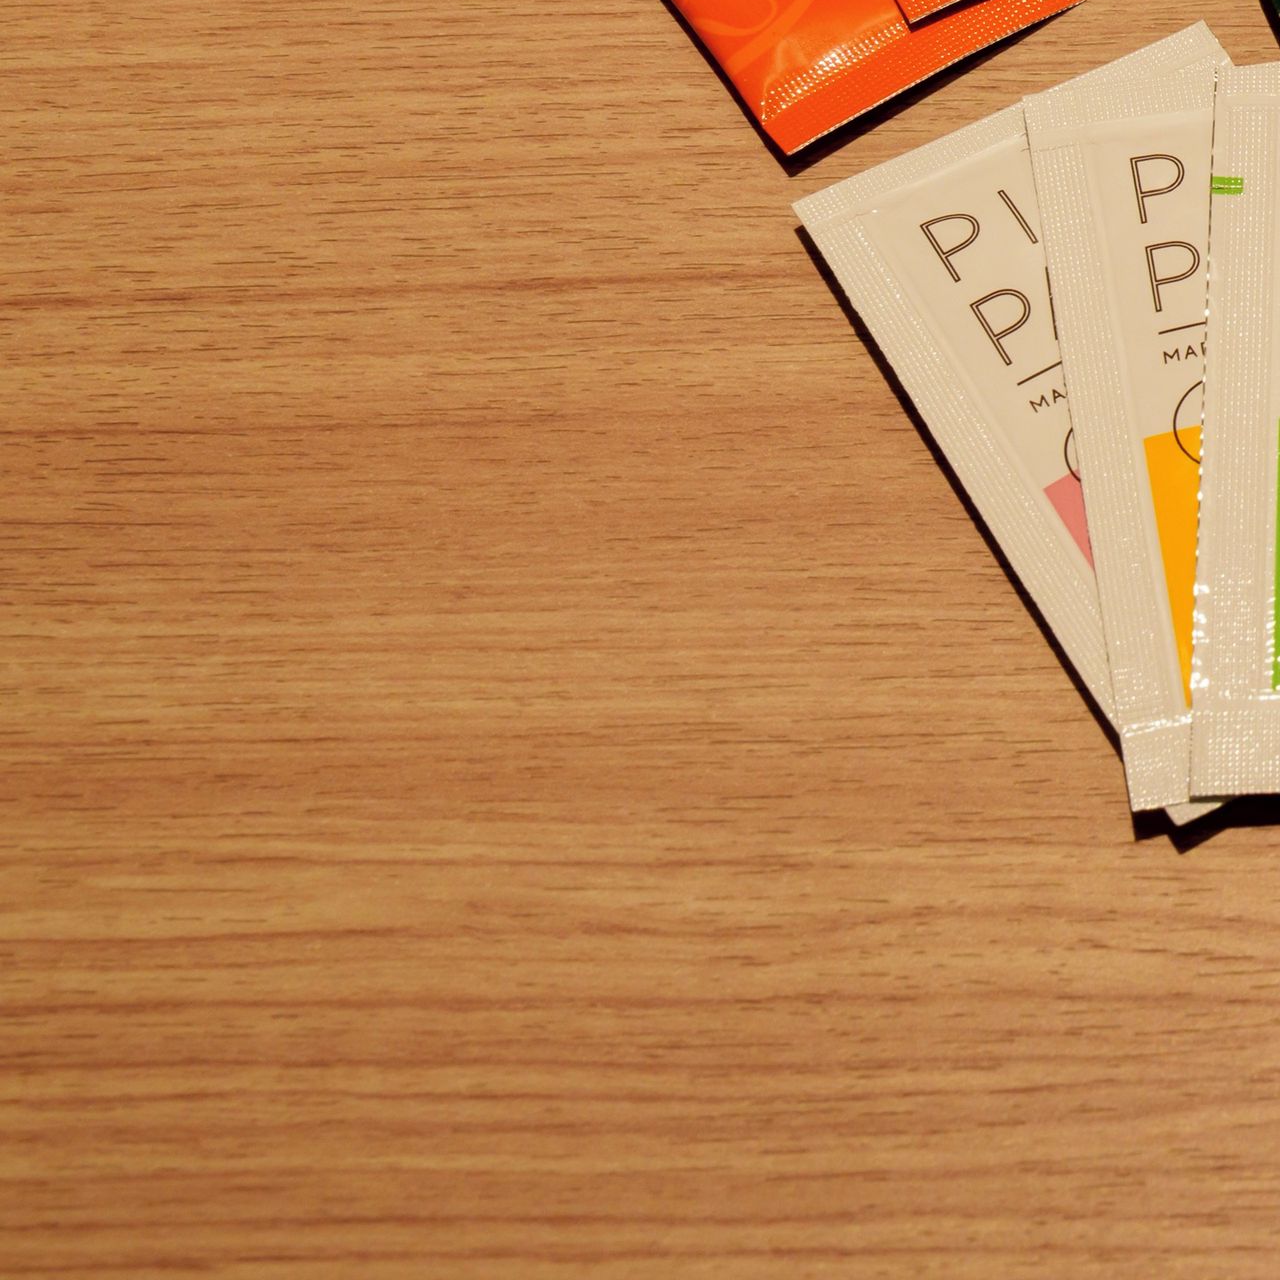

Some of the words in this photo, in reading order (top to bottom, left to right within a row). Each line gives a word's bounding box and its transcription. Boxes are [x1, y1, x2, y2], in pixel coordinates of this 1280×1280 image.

[920, 189, 1039, 283] PI
[1163, 341, 1207, 365] MA
[1029, 388, 1069, 414] MA
